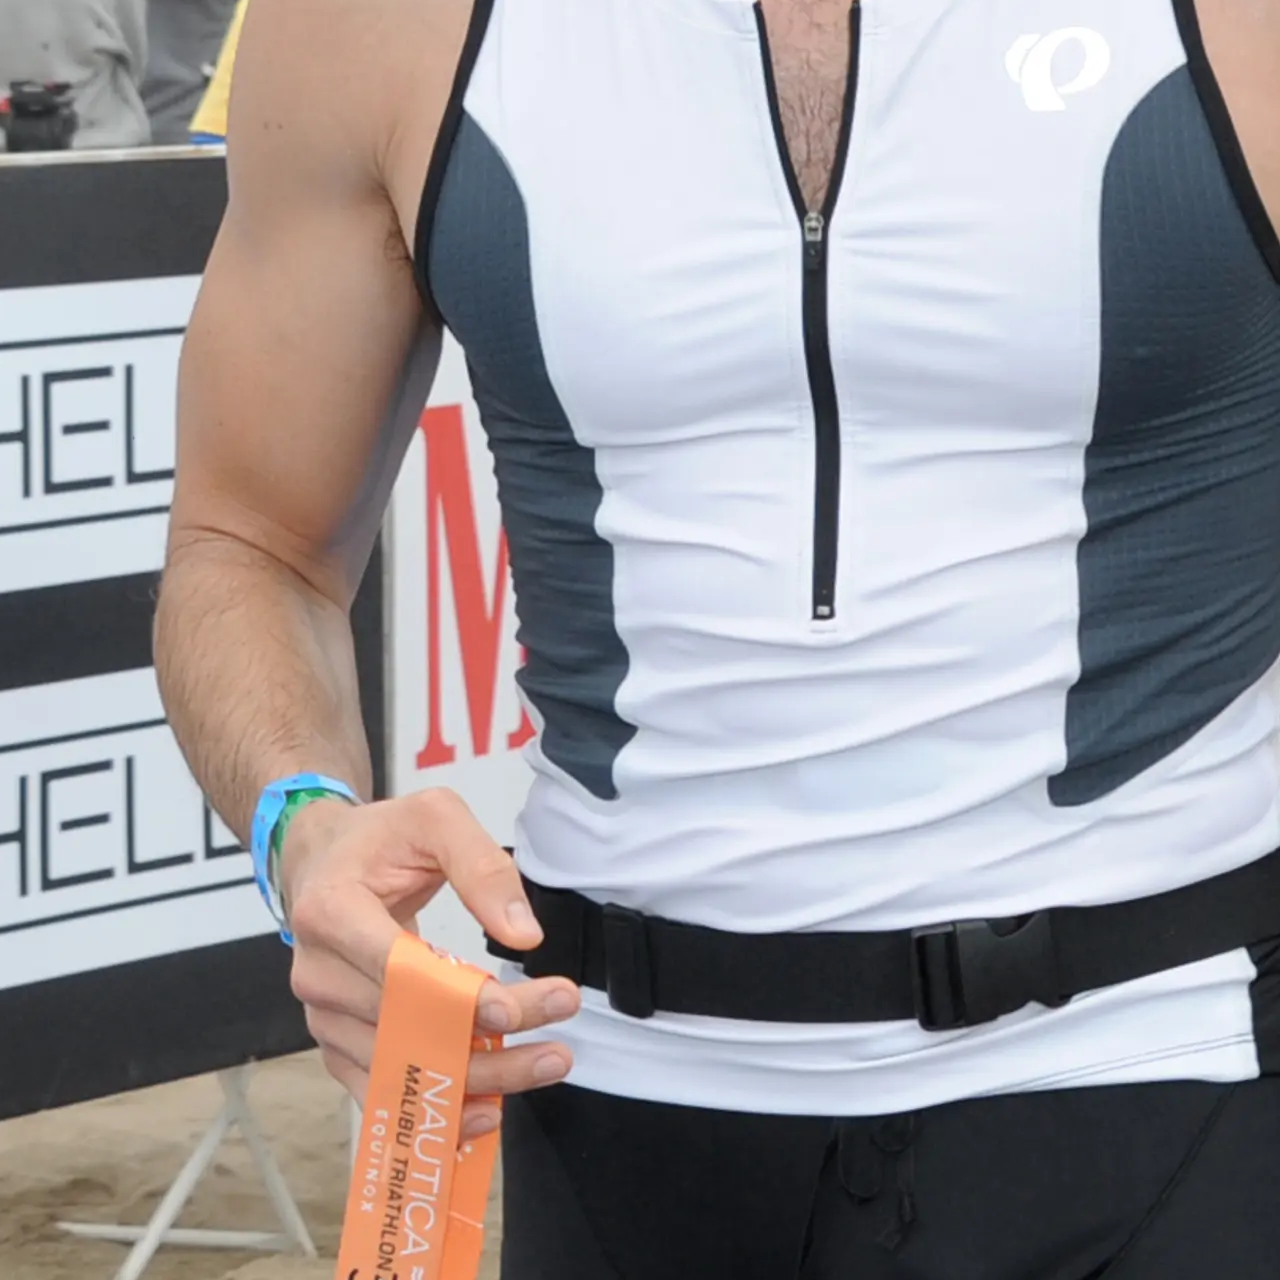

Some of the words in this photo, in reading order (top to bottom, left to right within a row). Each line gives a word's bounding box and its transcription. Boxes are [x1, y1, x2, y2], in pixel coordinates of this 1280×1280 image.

[360, 1107, 390, 1213] EQUINOX
[395, 1063, 422, 1149] MALIBU
[375, 1156, 410, 1272] TRIATHLON
[399, 1068, 454, 1256] NAUTICA
